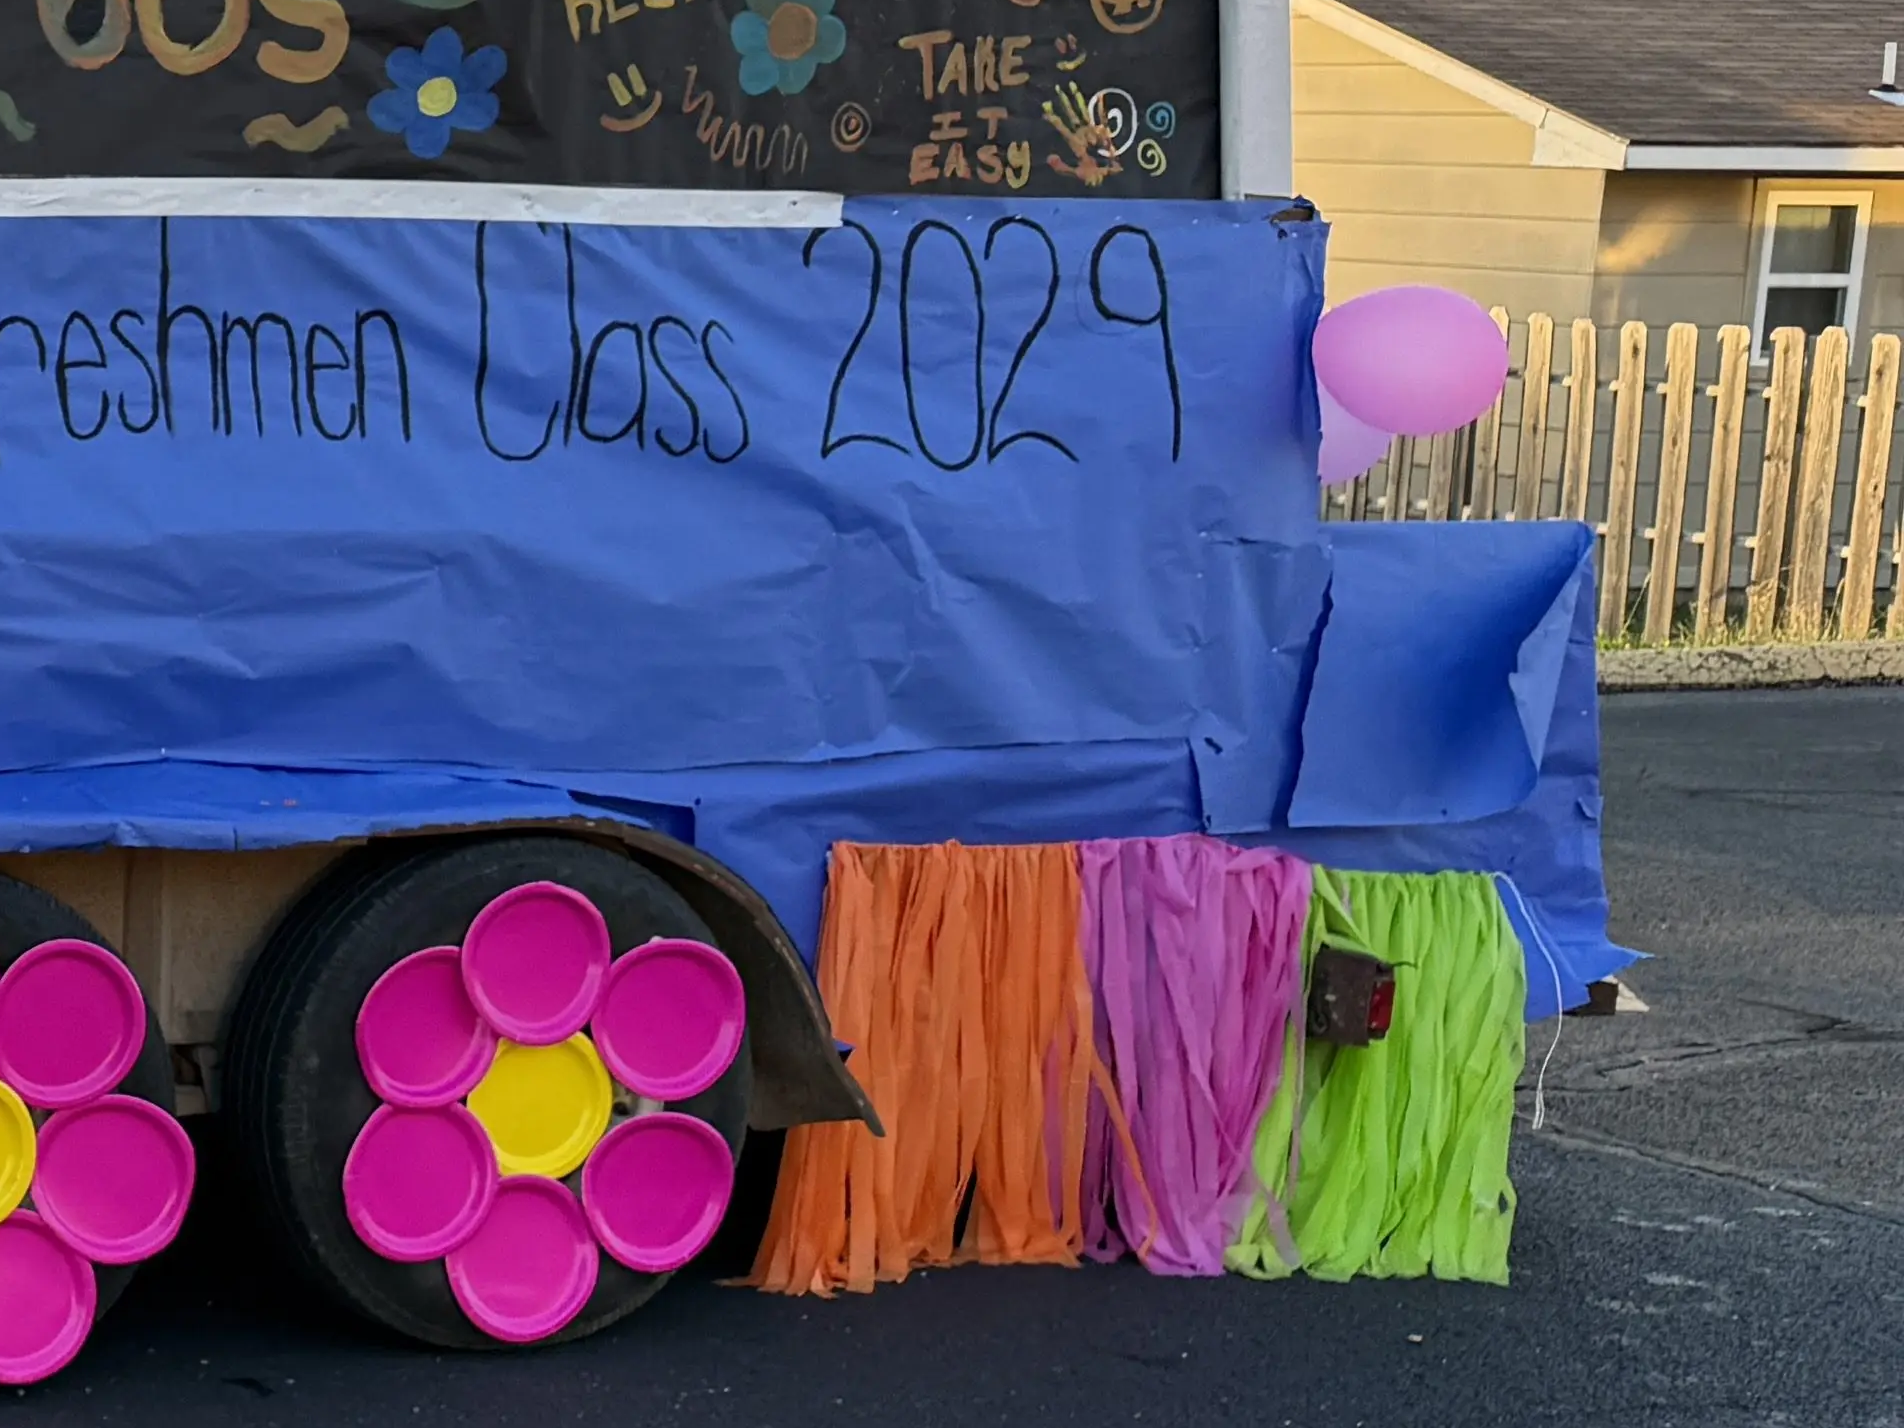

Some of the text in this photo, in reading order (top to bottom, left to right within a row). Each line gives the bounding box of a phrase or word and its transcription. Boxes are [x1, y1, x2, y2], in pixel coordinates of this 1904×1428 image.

[898, 28, 1033, 101] TAKE
[929, 106, 1010, 141] IT
[908, 138, 1033, 190] EASY
[475, 218, 752, 462] Class
[801, 217, 1181, 473] 2029
